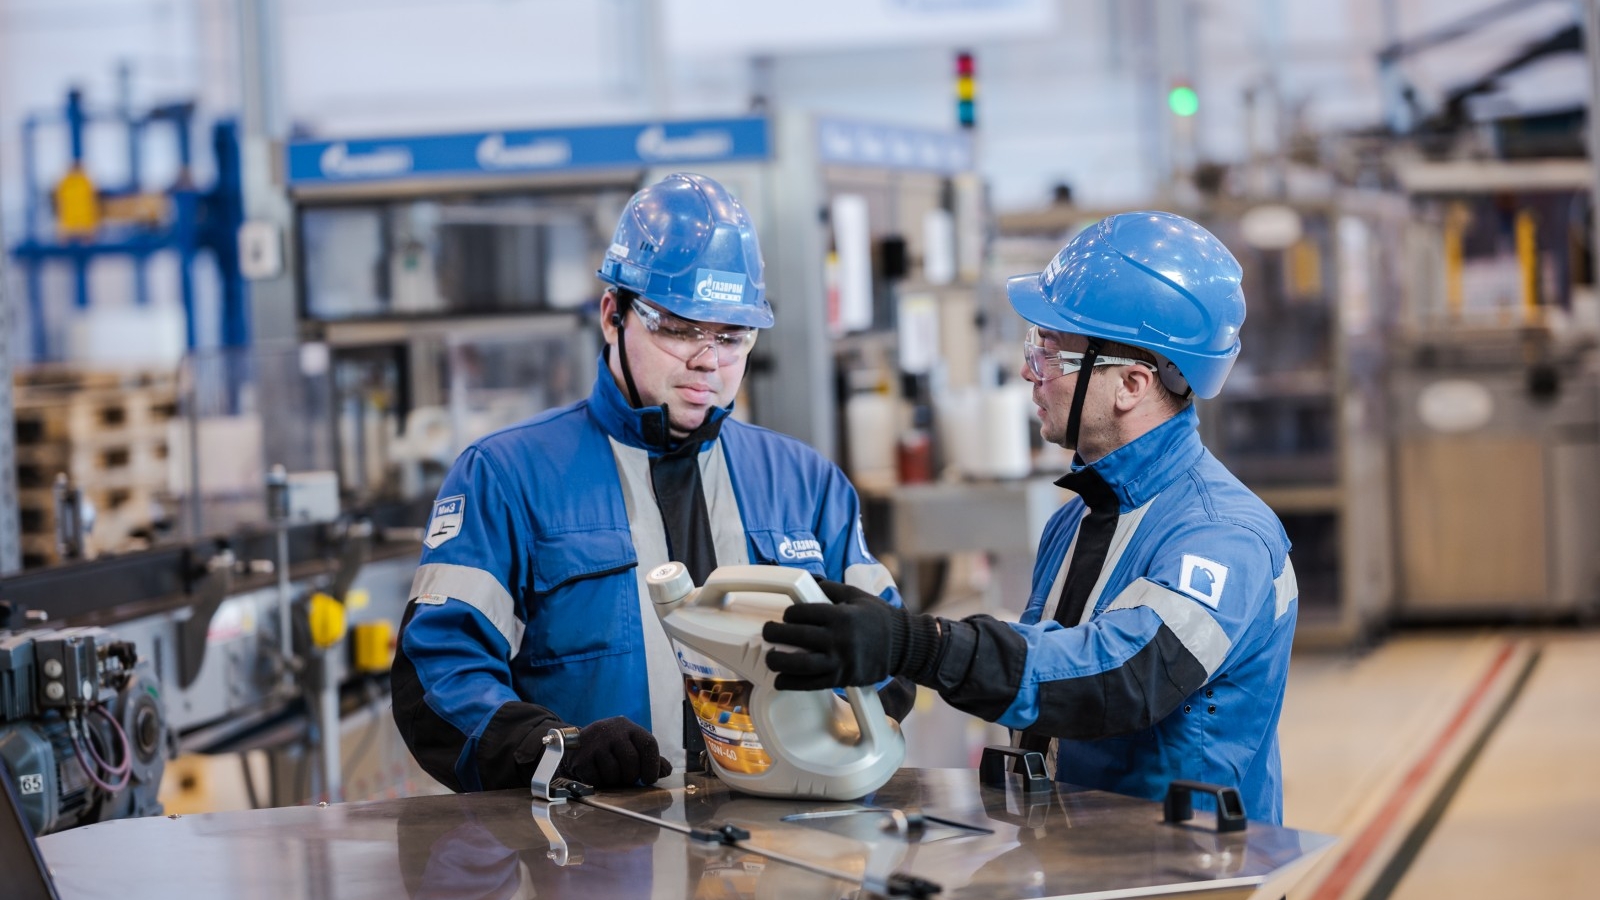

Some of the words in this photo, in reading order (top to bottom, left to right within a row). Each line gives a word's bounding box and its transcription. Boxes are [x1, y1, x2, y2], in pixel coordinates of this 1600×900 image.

[712, 280, 743, 294] ГАЗПРОМ
[708, 740, 738, 761] 10W-40
[23, 777, 41, 791] 65
